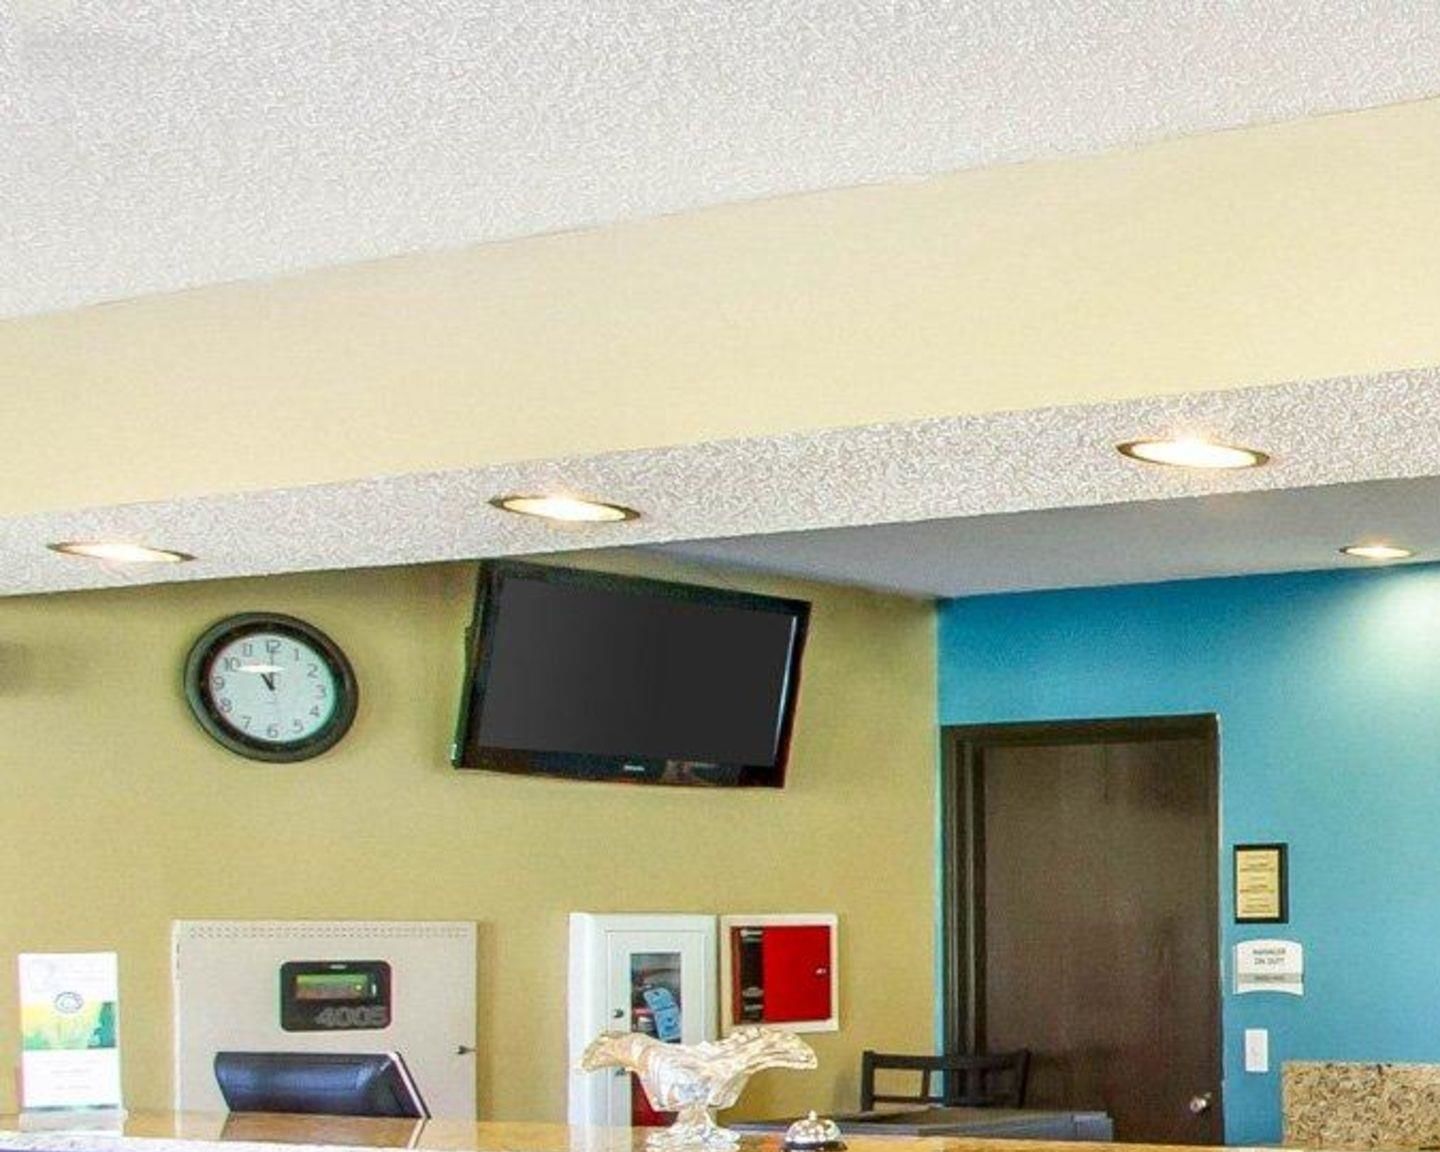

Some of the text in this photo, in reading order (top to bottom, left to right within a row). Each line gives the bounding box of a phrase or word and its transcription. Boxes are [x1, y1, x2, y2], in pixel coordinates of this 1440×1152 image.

[265, 639, 281, 653] 12
[293, 648, 300, 661] 1
[224, 657, 241, 672] 10
[307, 663, 318, 678] 2
[213, 676, 225, 691] 9
[316, 685, 327, 699] 3
[220, 698, 232, 713] 8
[309, 705, 320, 717] 4
[242, 716, 252, 730] 7
[293, 719, 304, 732] 5
[266, 724, 278, 738] 6
